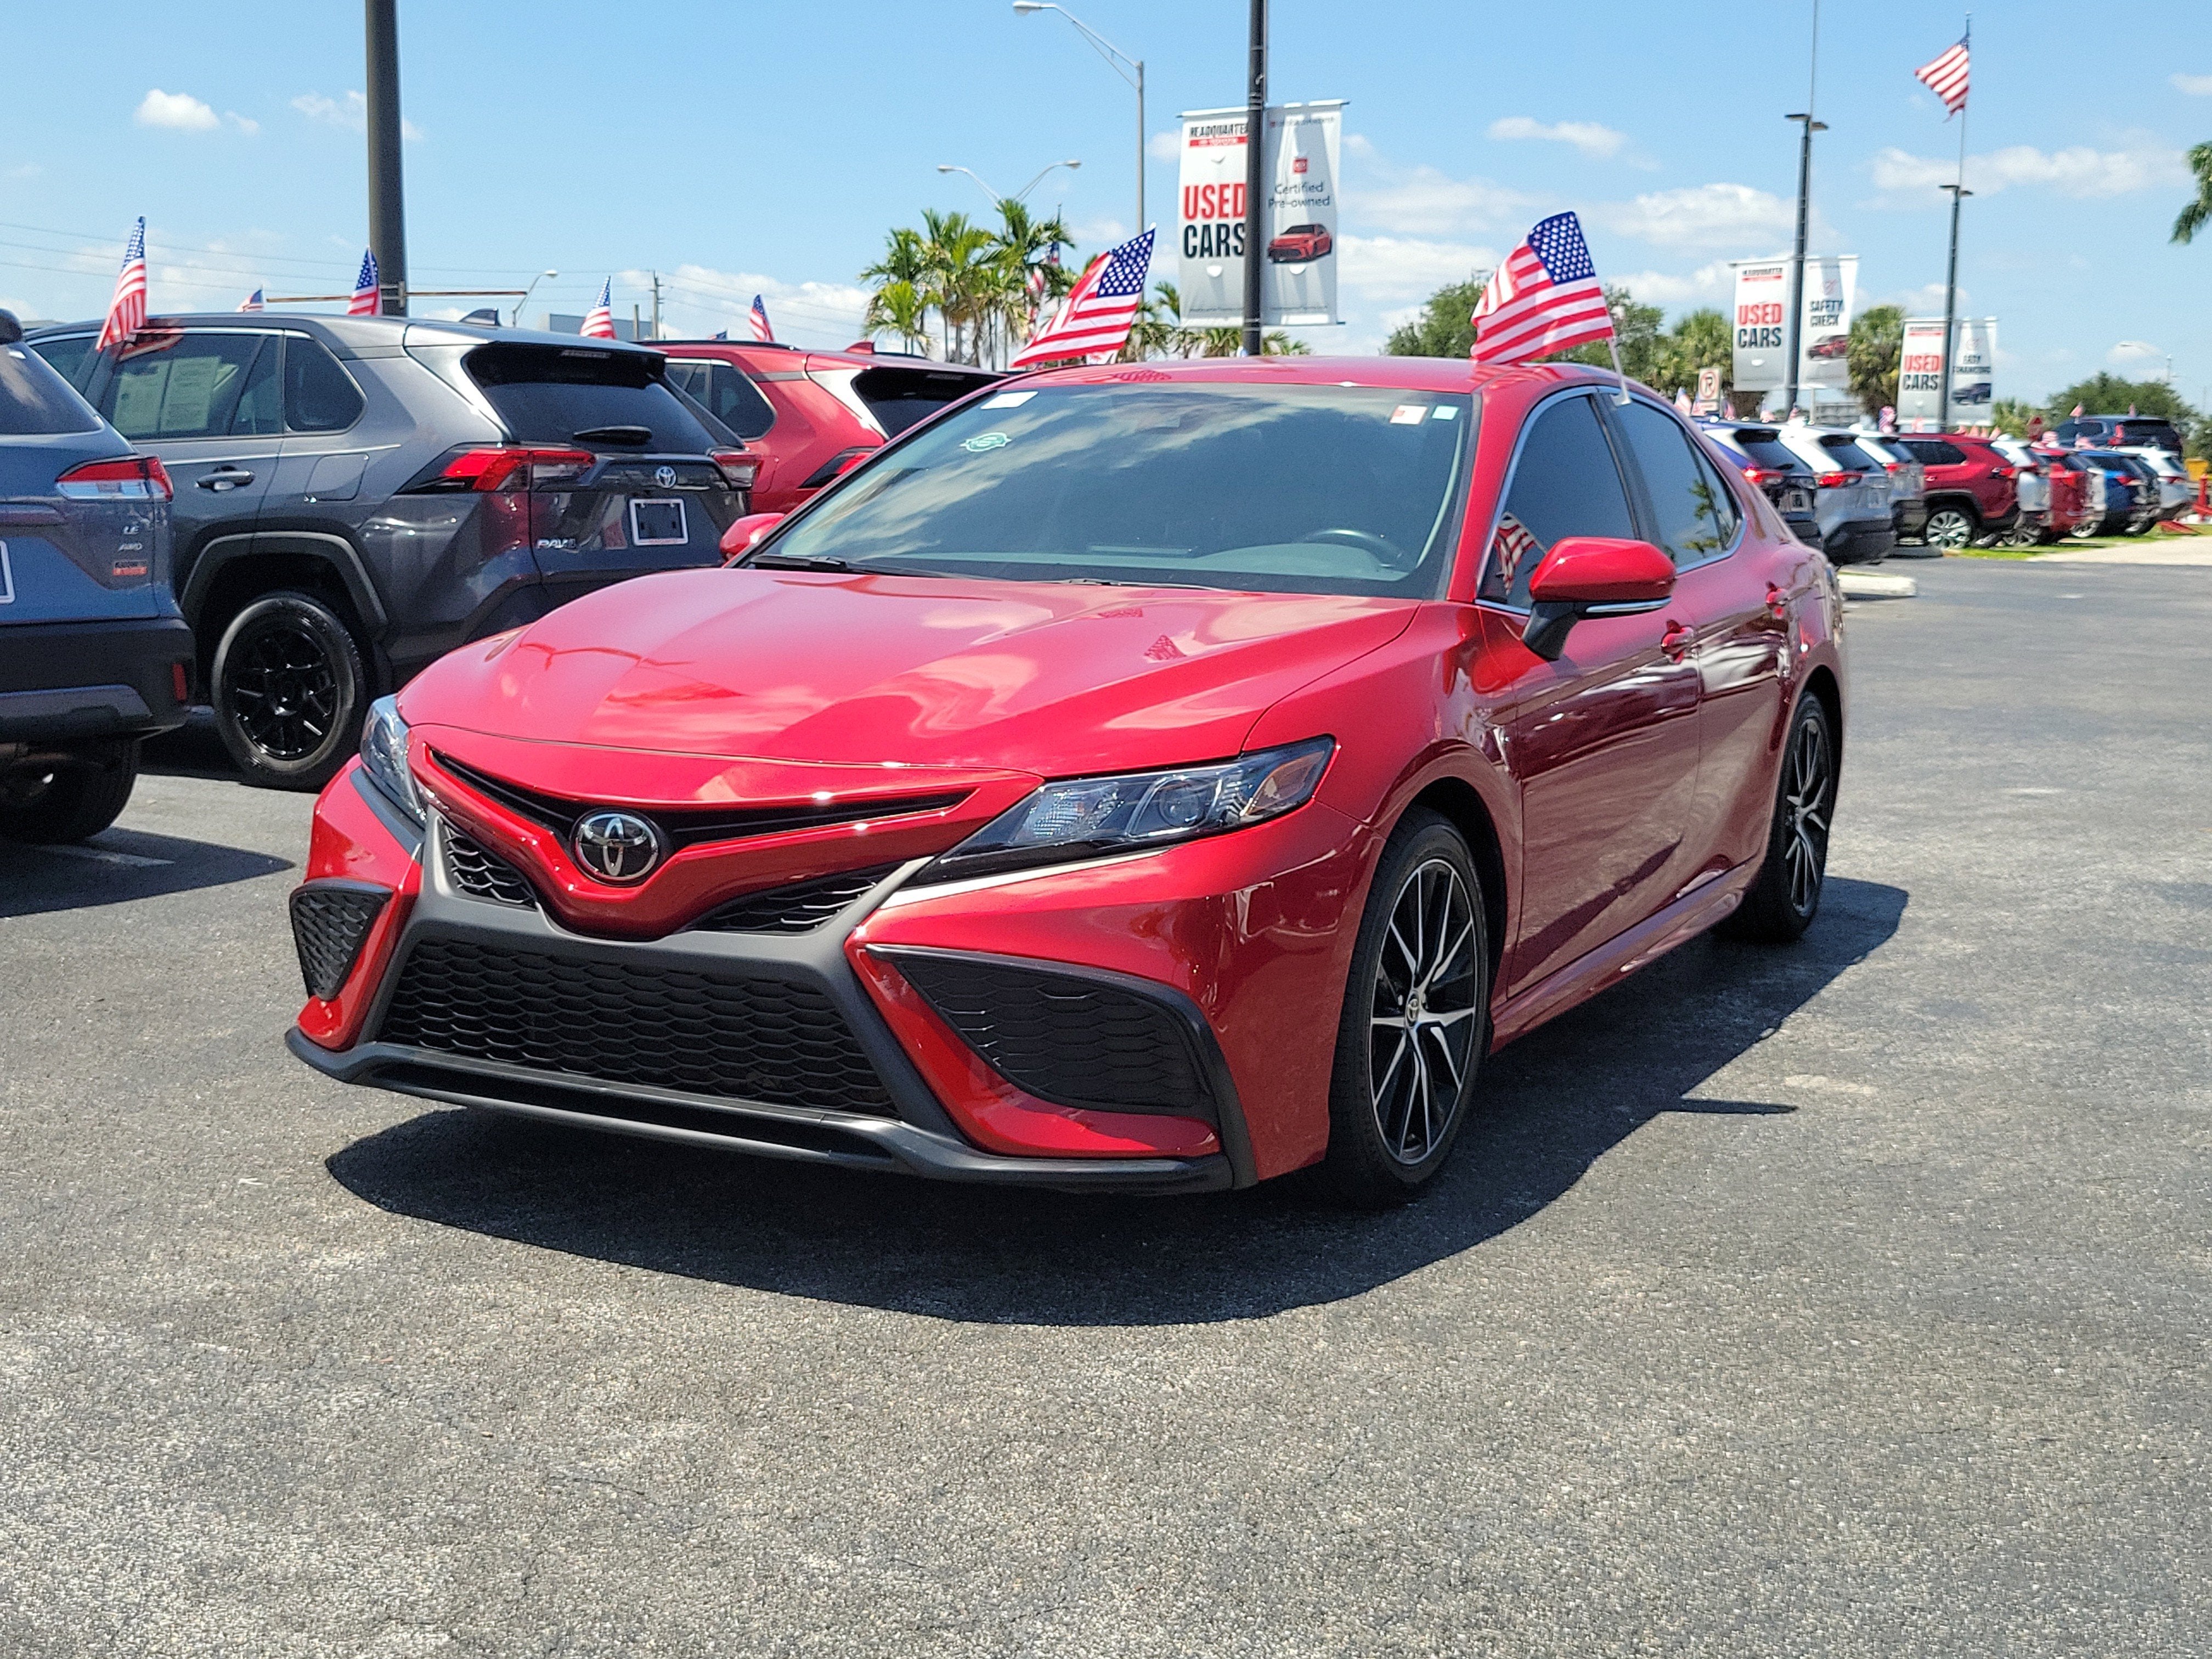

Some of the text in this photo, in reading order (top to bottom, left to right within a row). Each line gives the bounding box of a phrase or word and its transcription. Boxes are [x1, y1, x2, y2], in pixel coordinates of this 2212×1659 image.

[1274, 182, 1323, 194] Certified
[1184, 183, 1246, 219] USED
[1268, 195, 1330, 208] Pre-owned
[1184, 223, 1245, 258] CARS
[1738, 303, 1782, 325] USED
[1737, 327, 1782, 348] CARS
[1904, 355, 1940, 371] USED
[1903, 374, 1939, 391] CARS
[123, 526, 139, 534] LE
